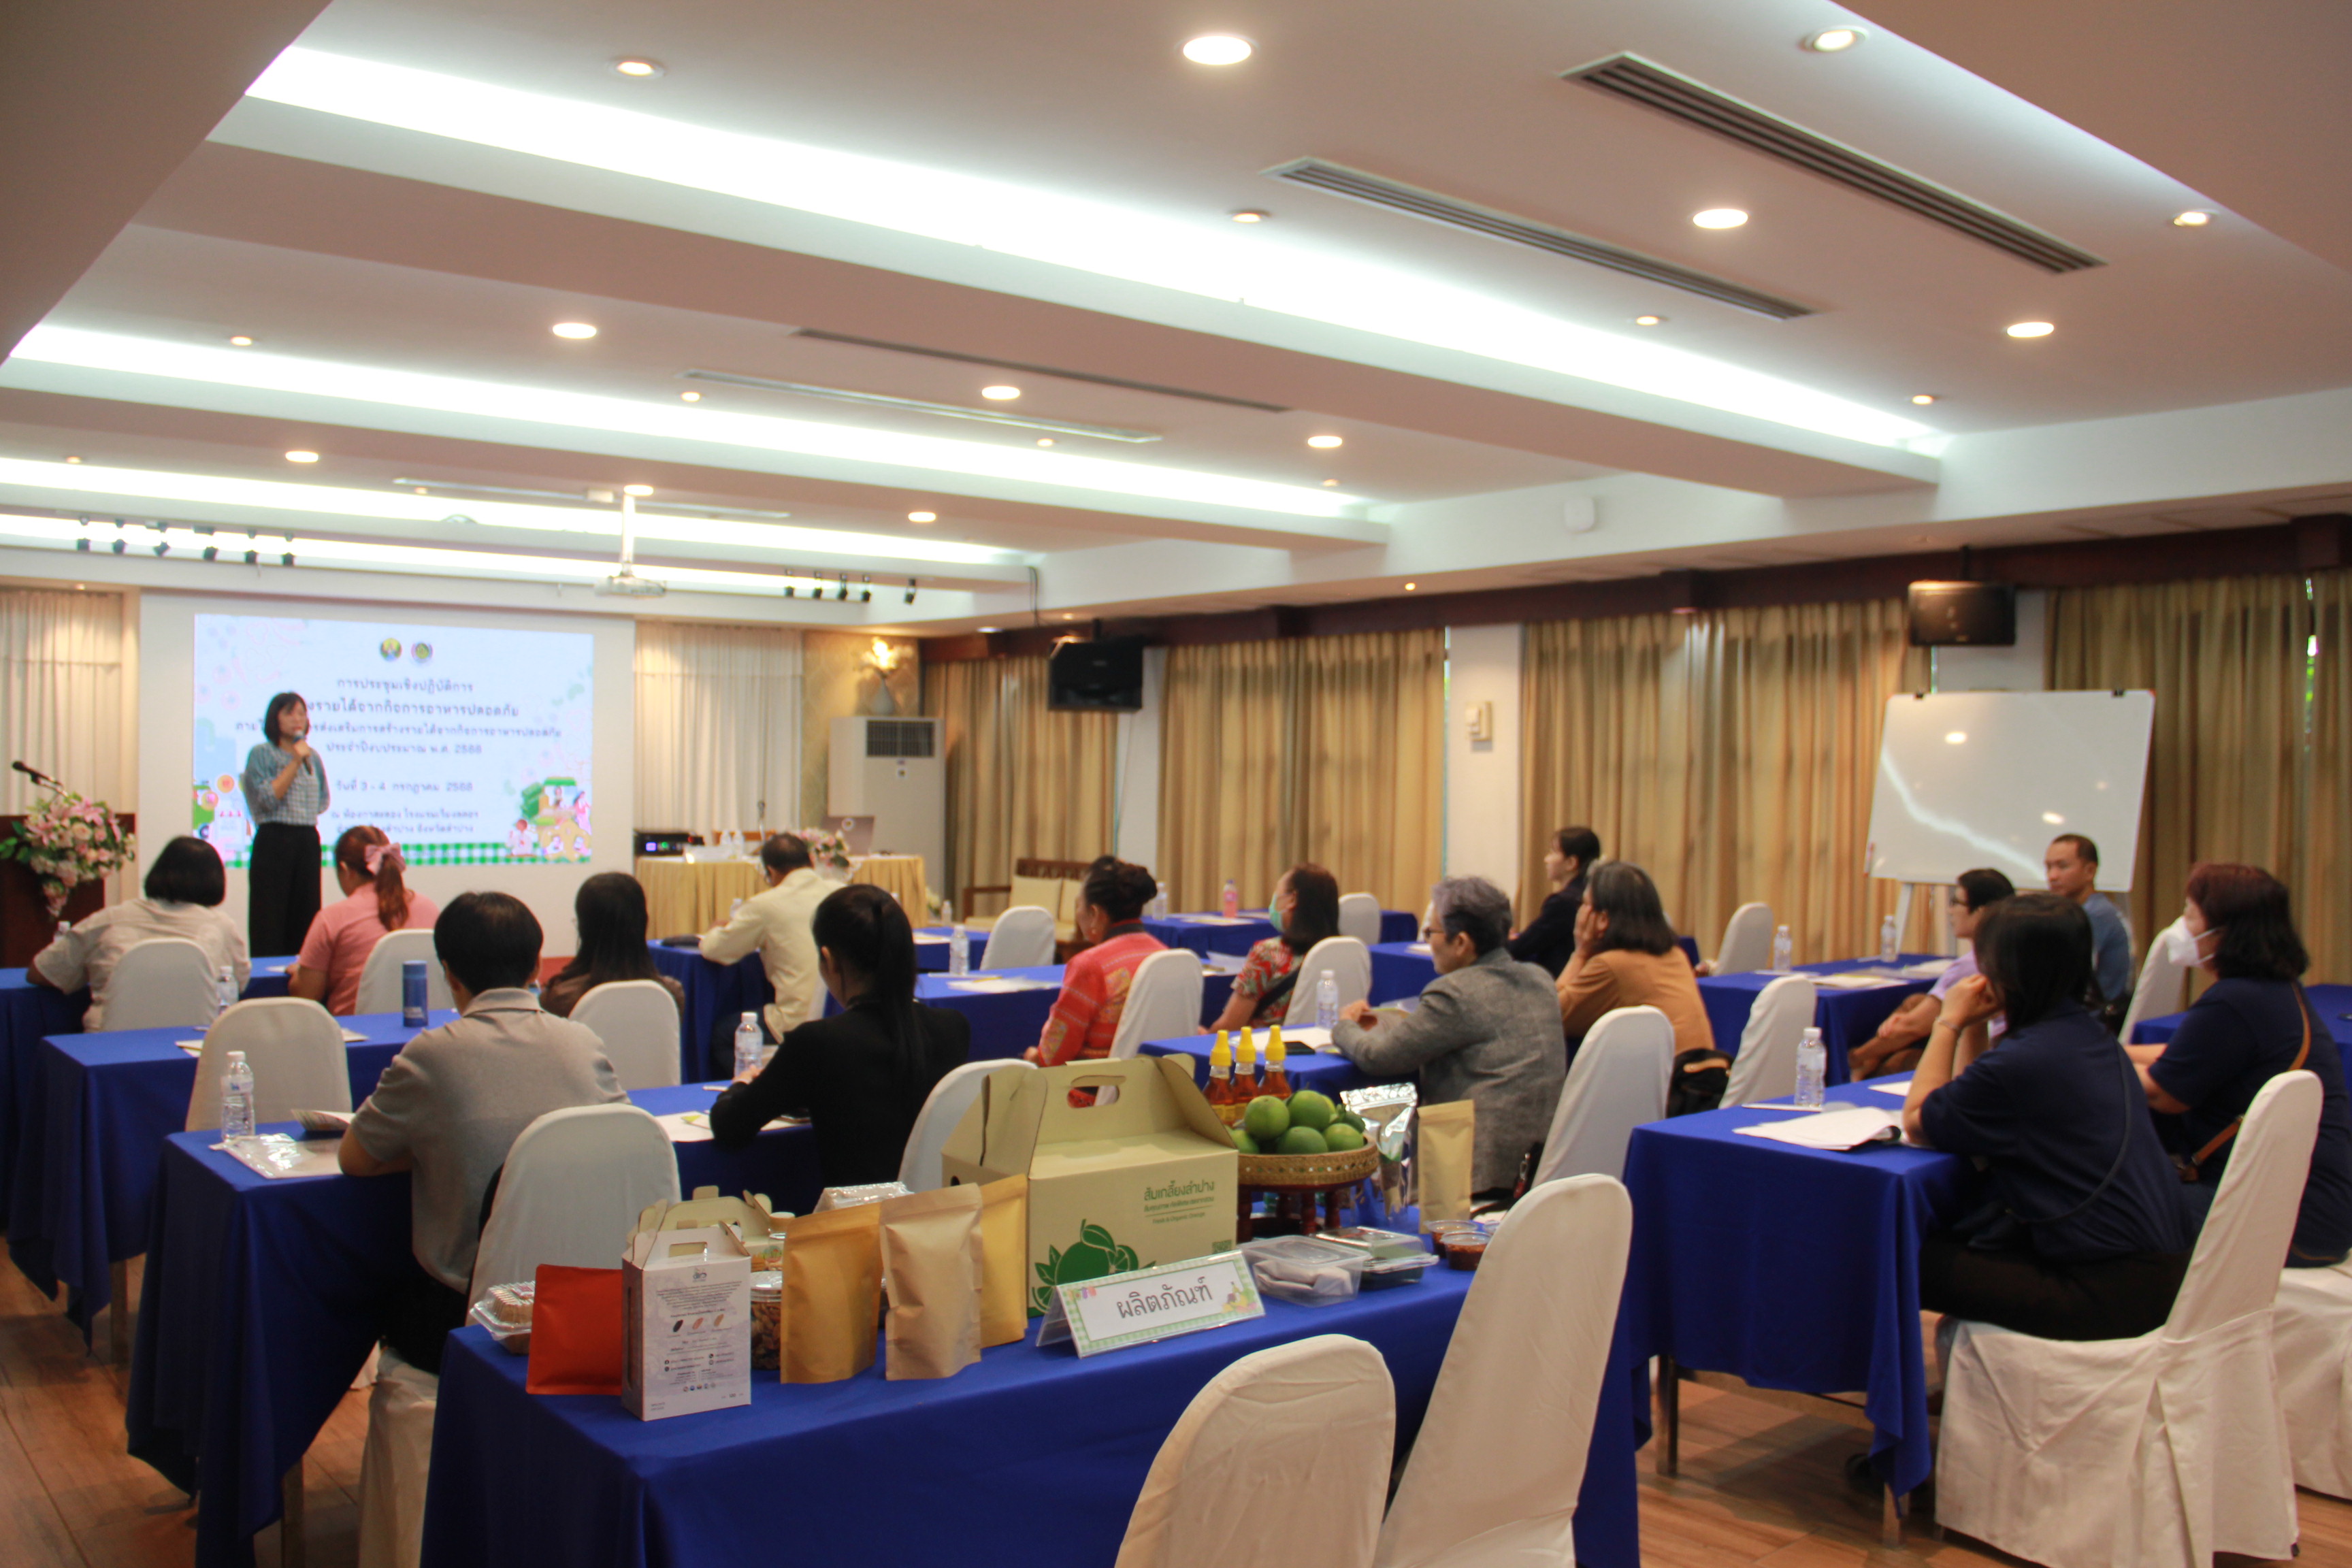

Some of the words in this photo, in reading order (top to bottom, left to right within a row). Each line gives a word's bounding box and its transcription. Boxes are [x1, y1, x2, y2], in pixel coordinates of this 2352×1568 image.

[308, 698, 519, 716] งรายได้จากกิจการอาหารปลอดภัย
[1143, 1179, 1215, 1201] ส้มเกลี้ยงลำปาง
[1116, 1275, 1213, 1320] ผลิตภัณฑ์
